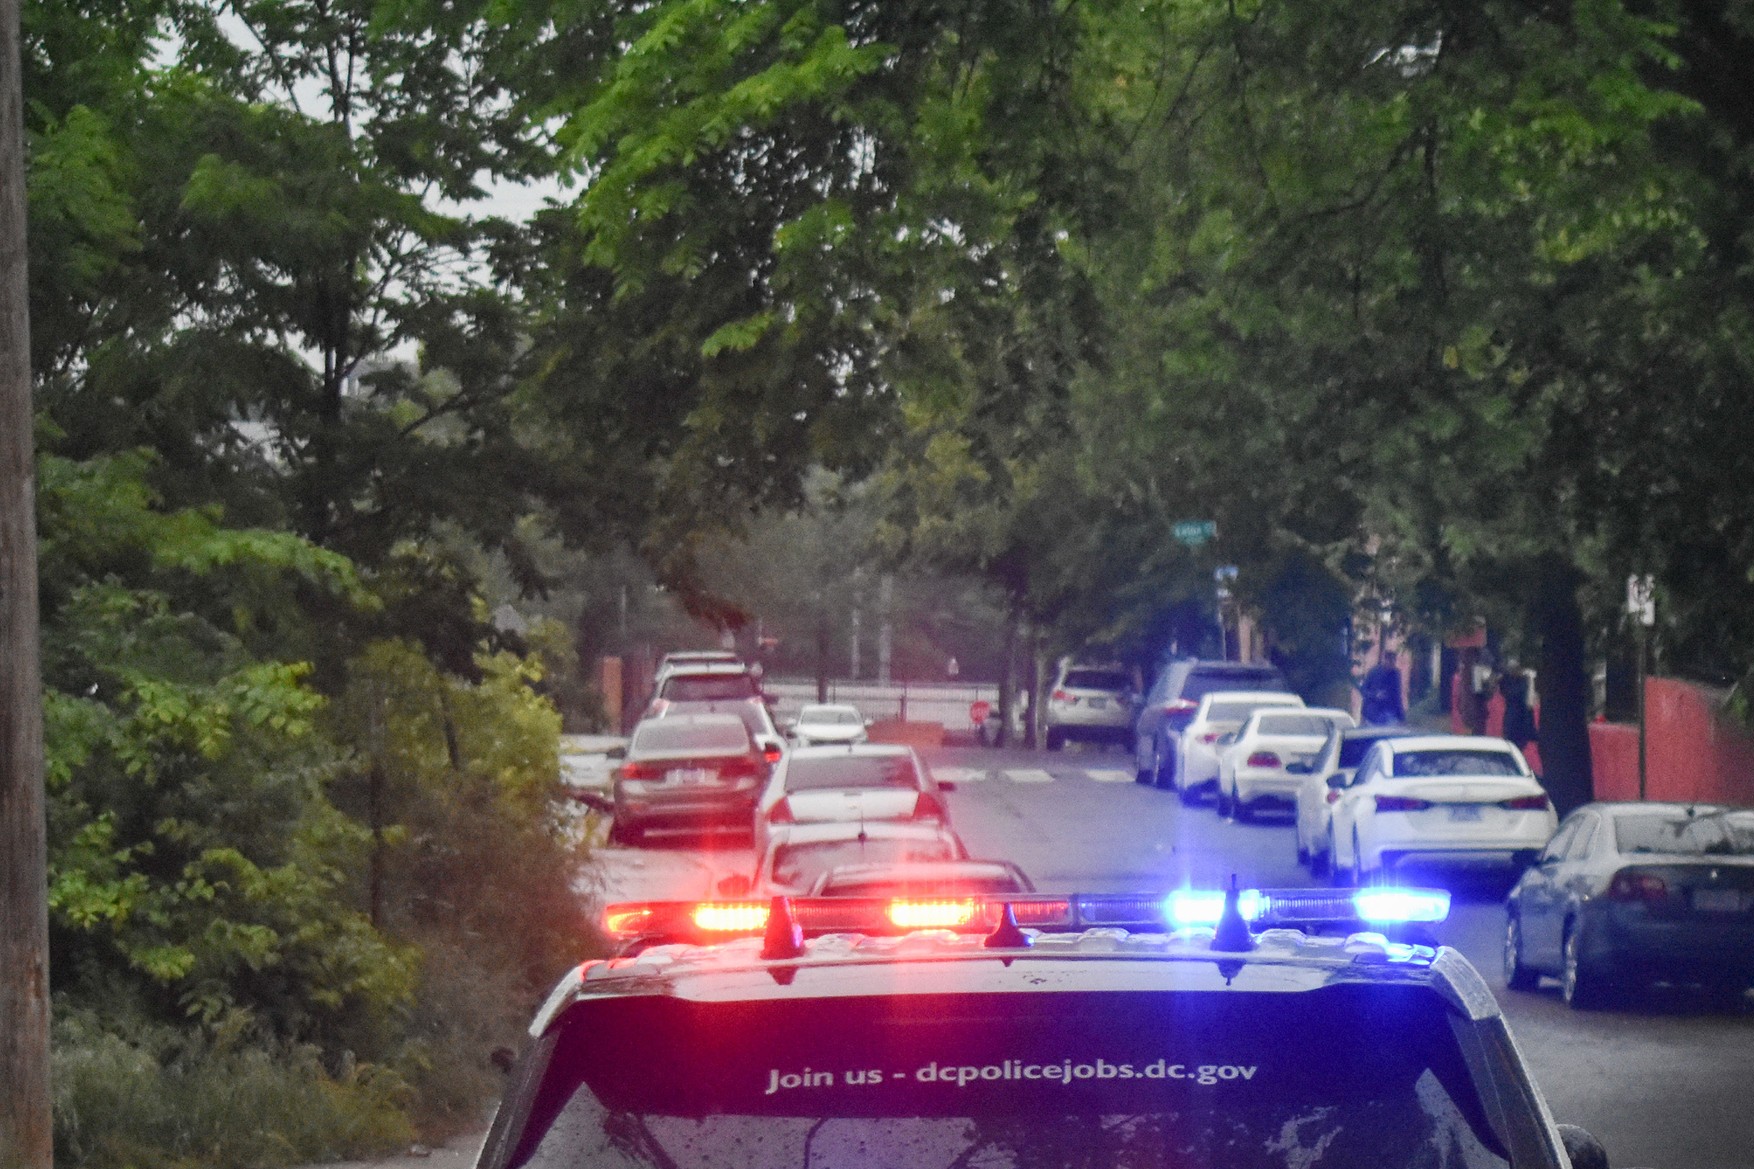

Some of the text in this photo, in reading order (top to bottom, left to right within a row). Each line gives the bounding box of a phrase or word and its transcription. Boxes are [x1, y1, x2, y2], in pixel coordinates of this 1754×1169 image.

[765, 1067, 834, 1095] Join
[845, 1069, 883, 1085] us
[916, 1059, 1258, 1086] dcpolicejobs.dc.gov
